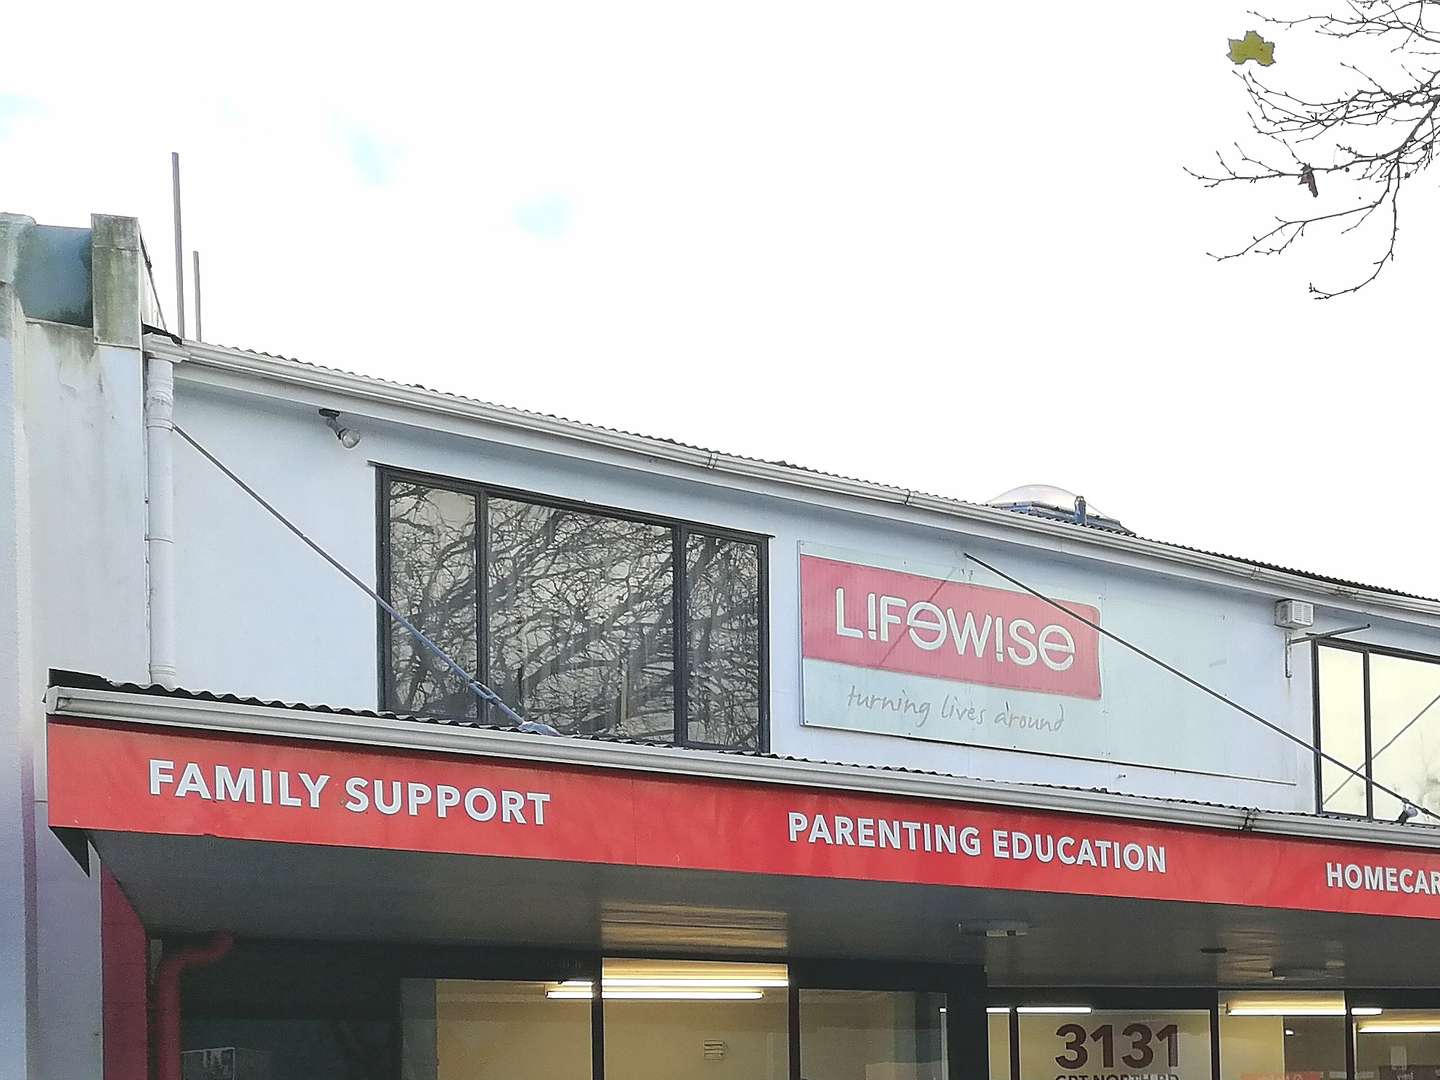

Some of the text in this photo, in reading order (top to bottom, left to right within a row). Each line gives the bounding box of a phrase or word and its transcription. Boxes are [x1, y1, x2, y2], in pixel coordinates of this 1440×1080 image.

[847, 685, 1064, 732] turning lives around
[149, 759, 551, 825] FAMILY SUPPORT
[787, 812, 1167, 873] PARENTING EDUCATION
[1055, 1023, 1178, 1070] 3131
